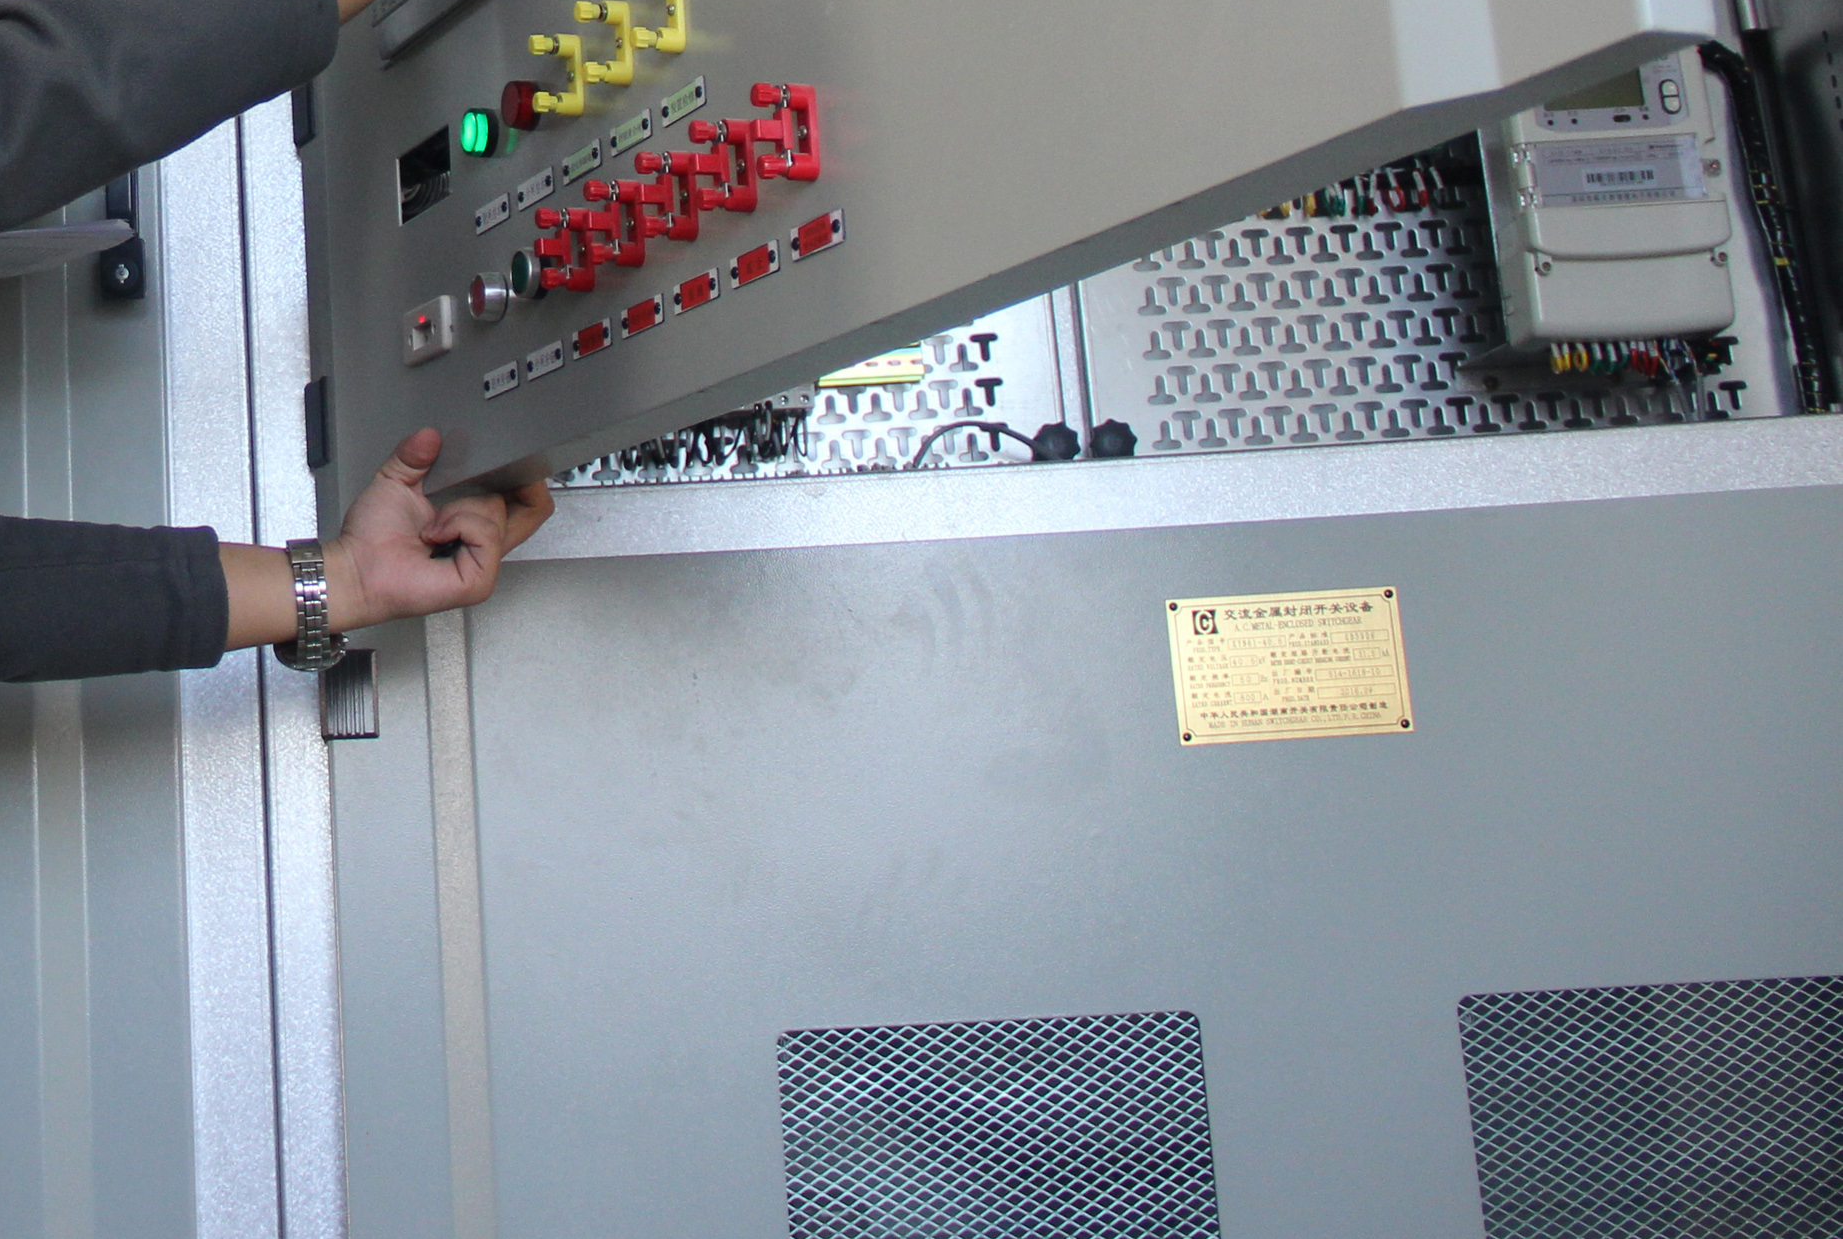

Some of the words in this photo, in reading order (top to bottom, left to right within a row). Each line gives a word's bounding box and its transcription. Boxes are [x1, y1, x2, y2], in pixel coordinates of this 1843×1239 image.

[1223, 600, 1373, 620] 交流金属封闭开关设备
[1317, 616, 1362, 626] SWITCHGEAR
